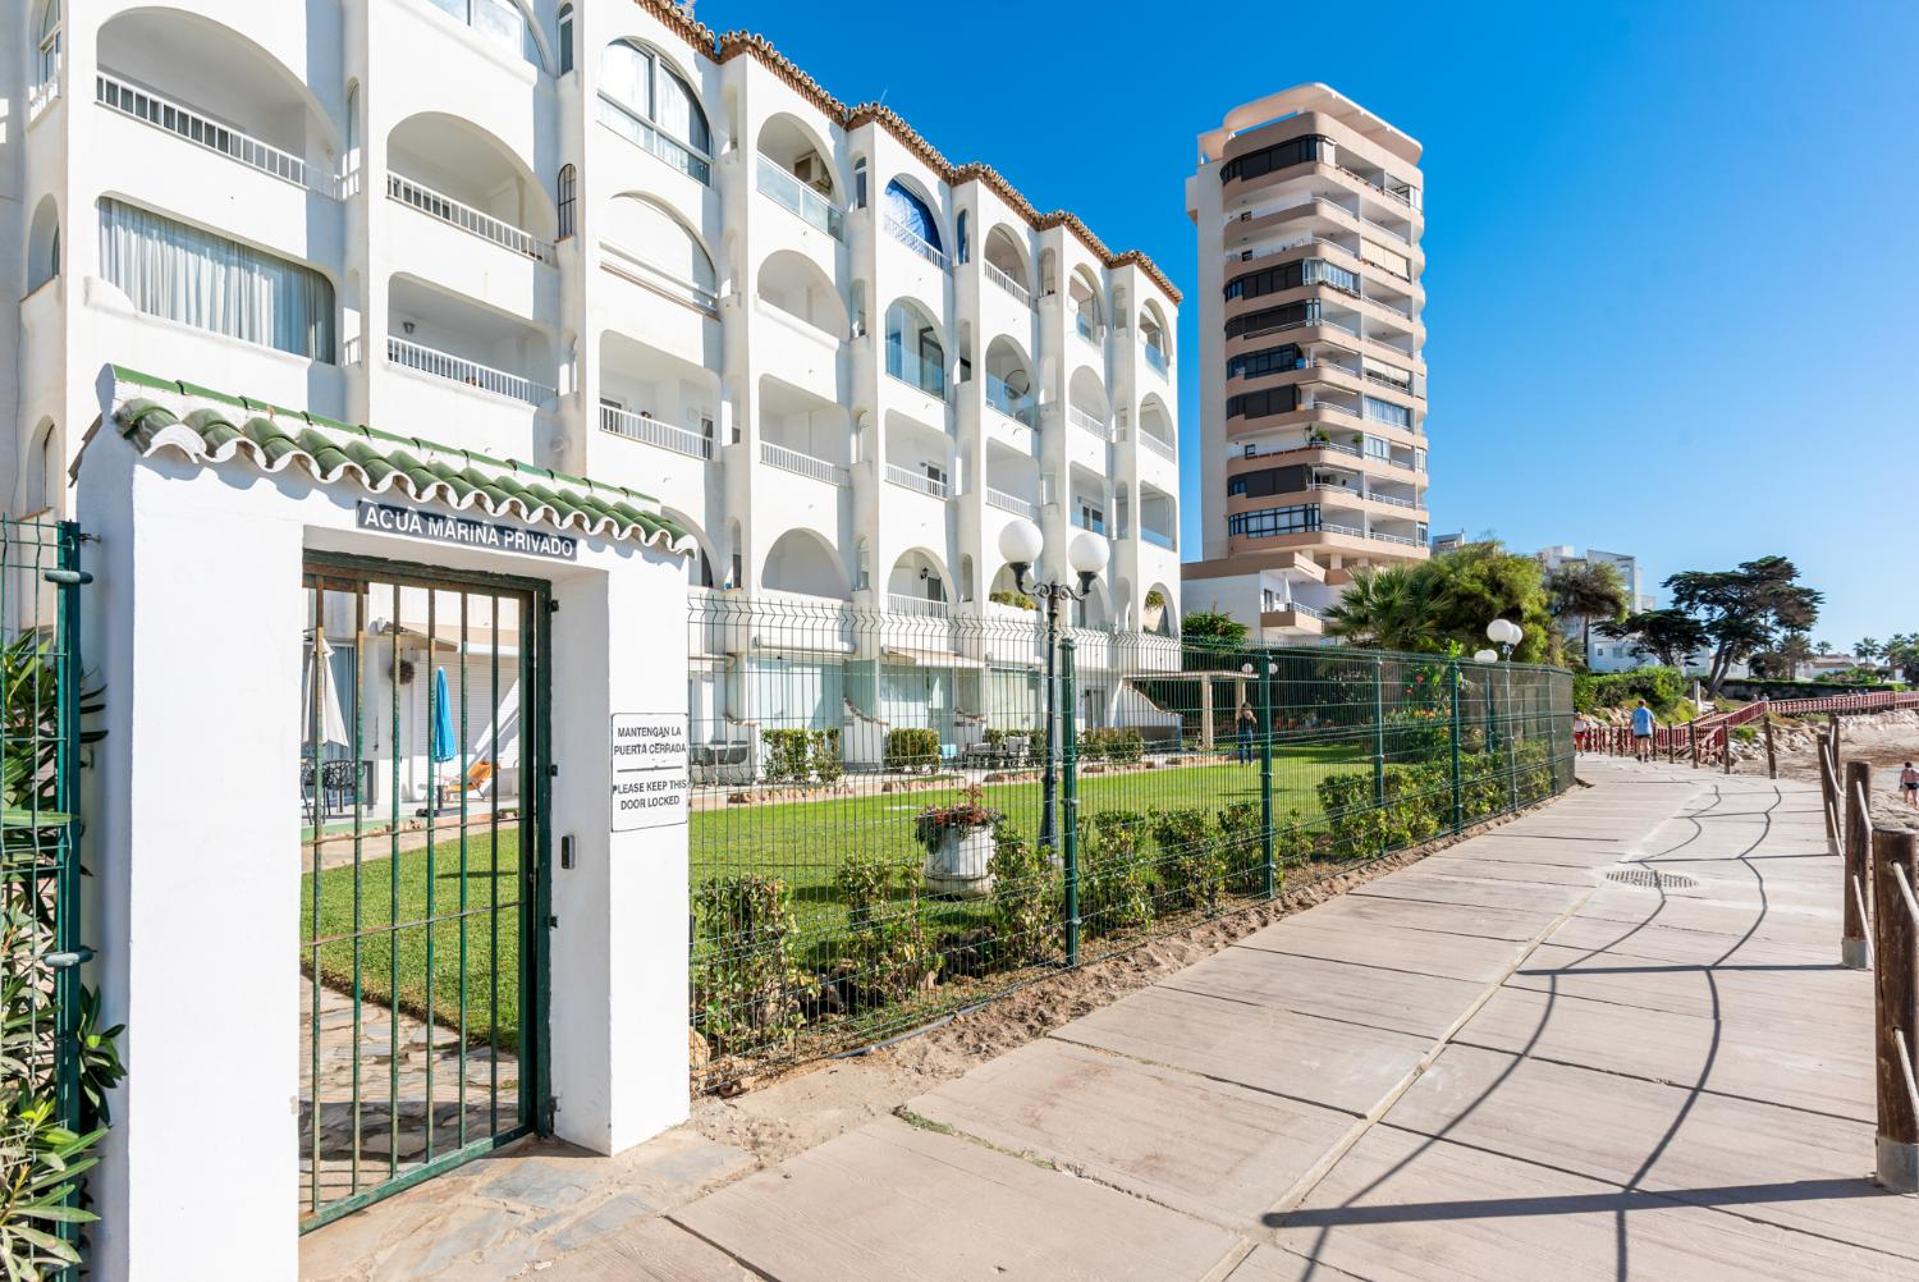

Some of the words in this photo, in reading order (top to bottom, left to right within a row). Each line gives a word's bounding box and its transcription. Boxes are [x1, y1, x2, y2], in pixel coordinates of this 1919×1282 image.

[428, 518, 499, 546] MARINA
[504, 530, 573, 557] PRIVADO
[617, 727, 670, 738] MANTENGAN
[672, 726, 682, 736] LA
[613, 744, 647, 755] PUERTA
[649, 743, 686, 754] CERRADA
[612, 783, 645, 794] PLEASE
[647, 781, 668, 792] KEEP
[670, 780, 687, 789] THIS
[620, 799, 646, 810] DOOR
[648, 796, 680, 807] LOCKED
